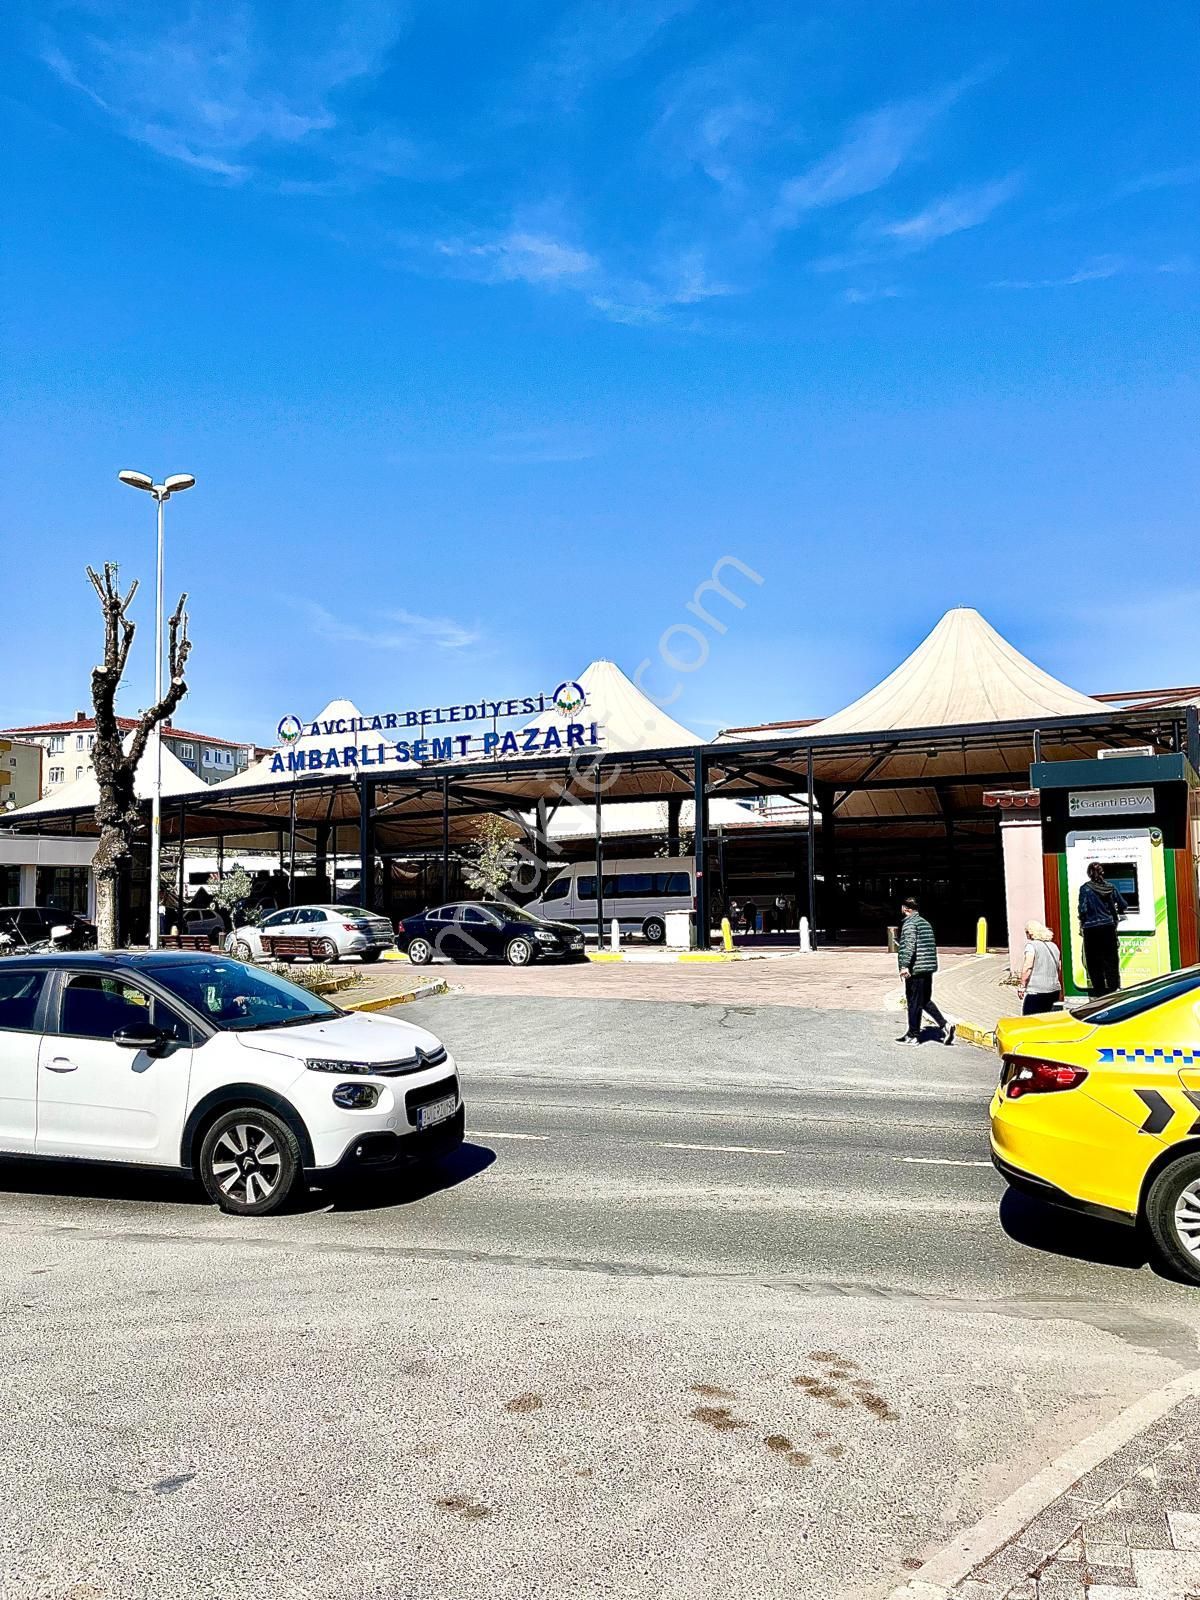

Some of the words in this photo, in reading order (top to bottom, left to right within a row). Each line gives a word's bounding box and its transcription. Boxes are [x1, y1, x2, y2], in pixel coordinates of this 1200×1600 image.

[311, 713, 397, 736] AVCILAR
[406, 692, 545, 727] BELEDİYESİ
[271, 743, 385, 773] AMBARLI
[395, 735, 471, 763] SEMT
[484, 722, 598, 755] PAZARI
[1080, 798, 1117, 808] Garanti
[1119, 796, 1152, 806] BBVA
